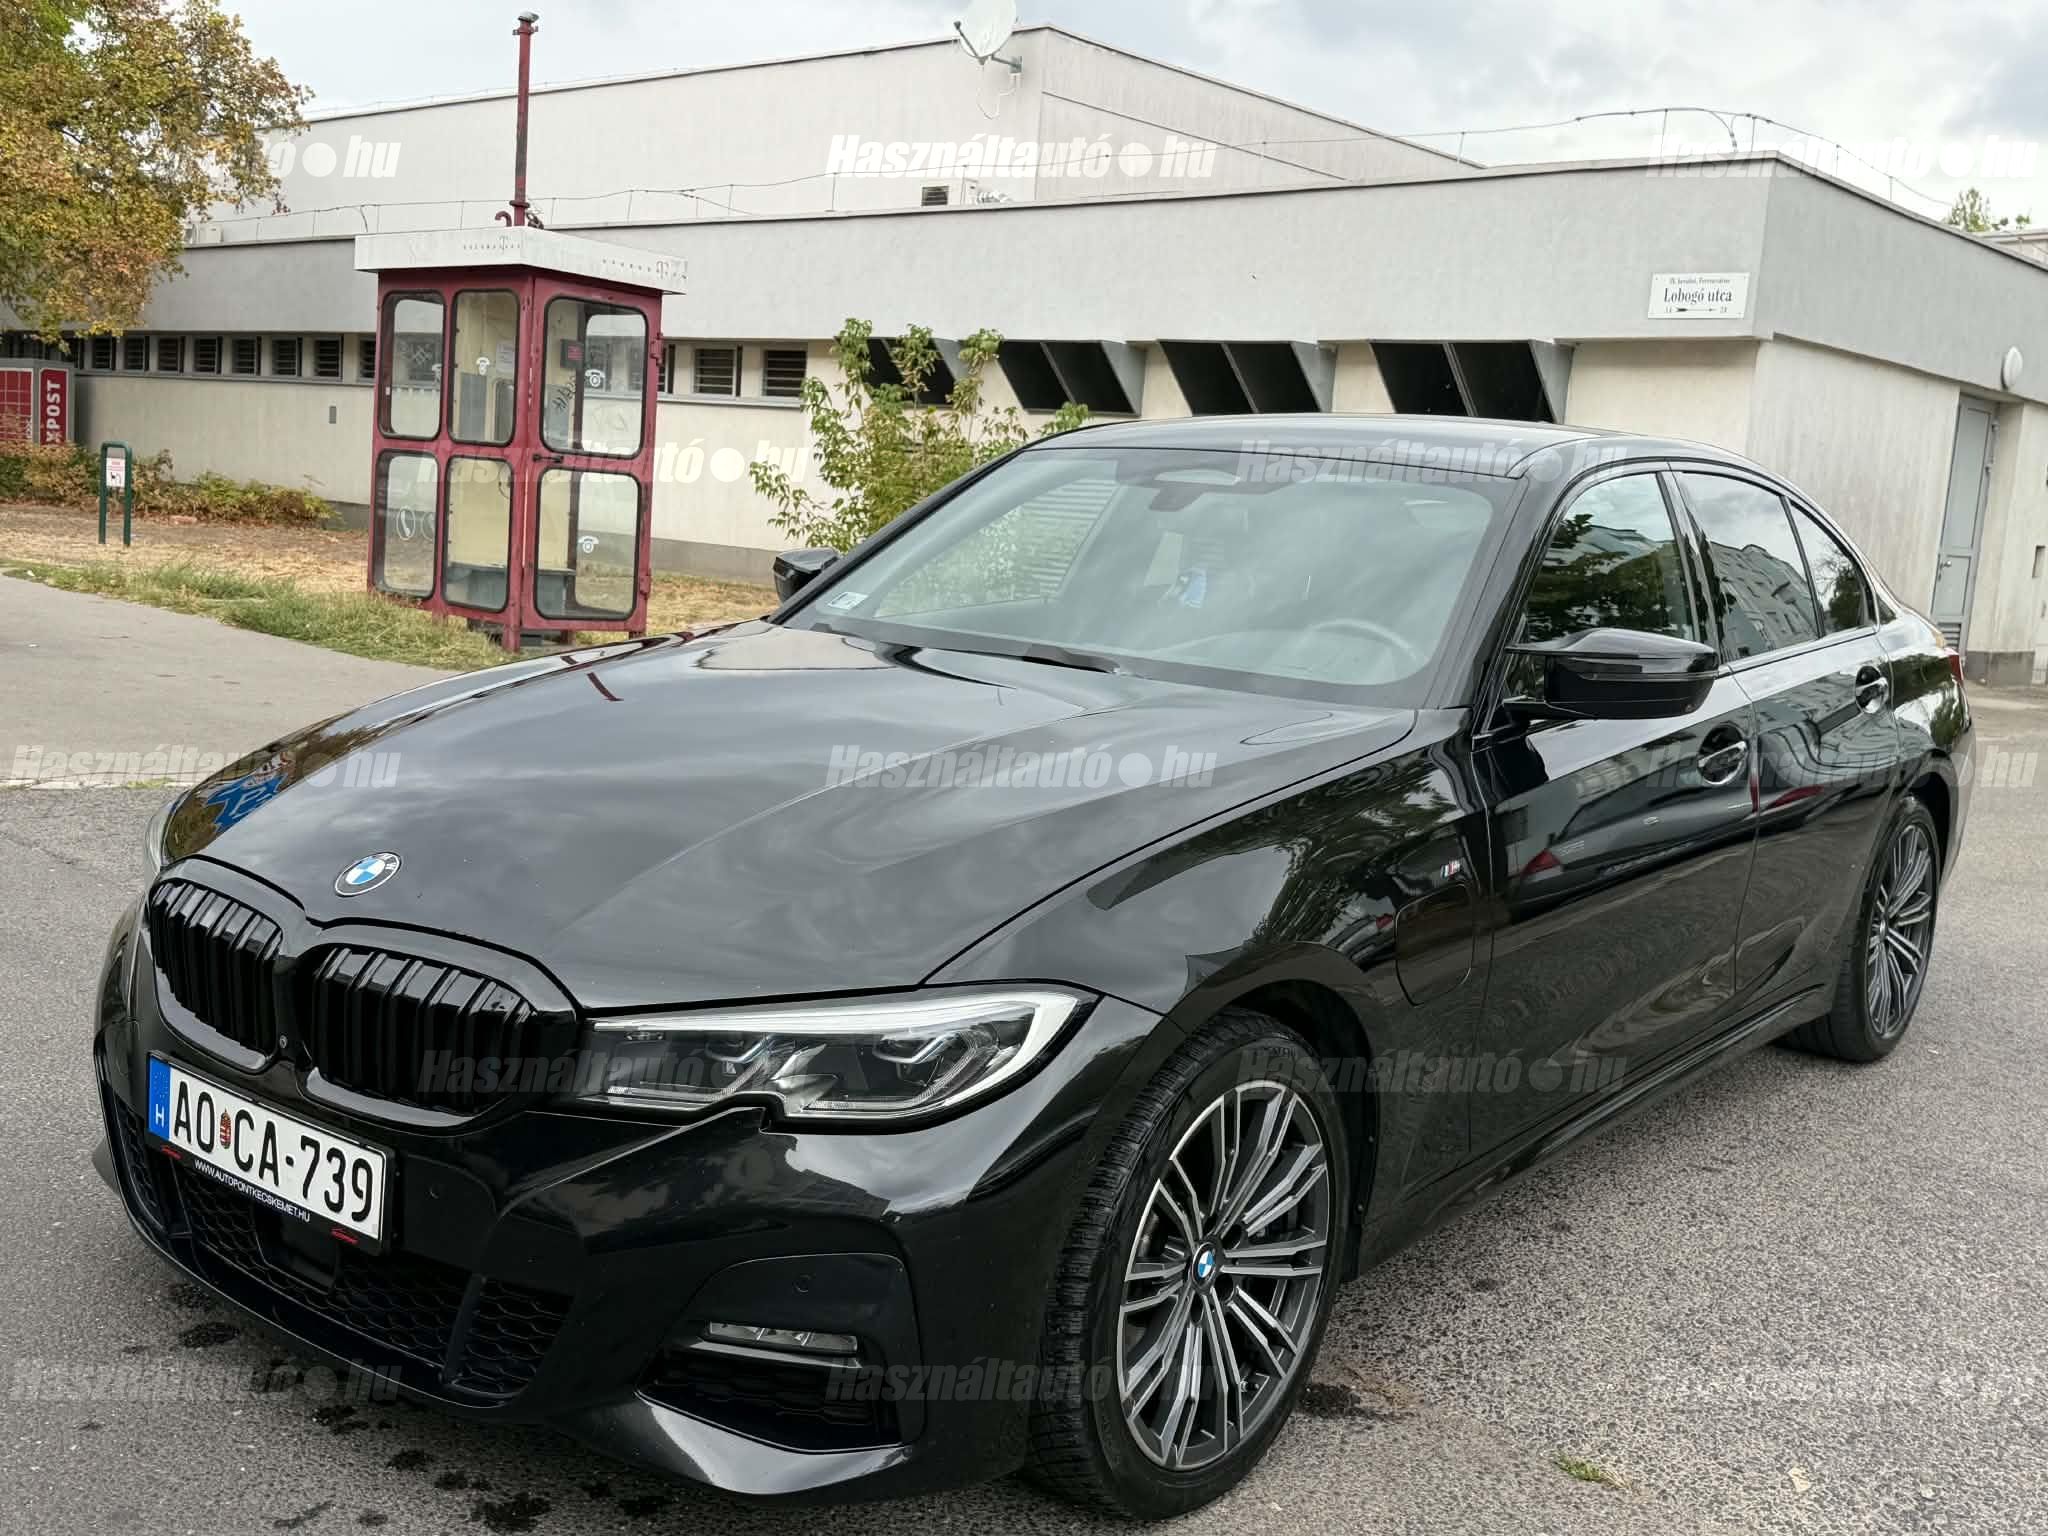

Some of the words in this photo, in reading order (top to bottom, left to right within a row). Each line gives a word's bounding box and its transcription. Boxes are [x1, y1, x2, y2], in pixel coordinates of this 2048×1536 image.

[1664, 287, 1705, 305] Lobogó
[1708, 288, 1732, 303] utca
[155, 1103, 165, 1128] H
[173, 1080, 216, 1154] AO
[233, 1108, 374, 1223] CA-739
